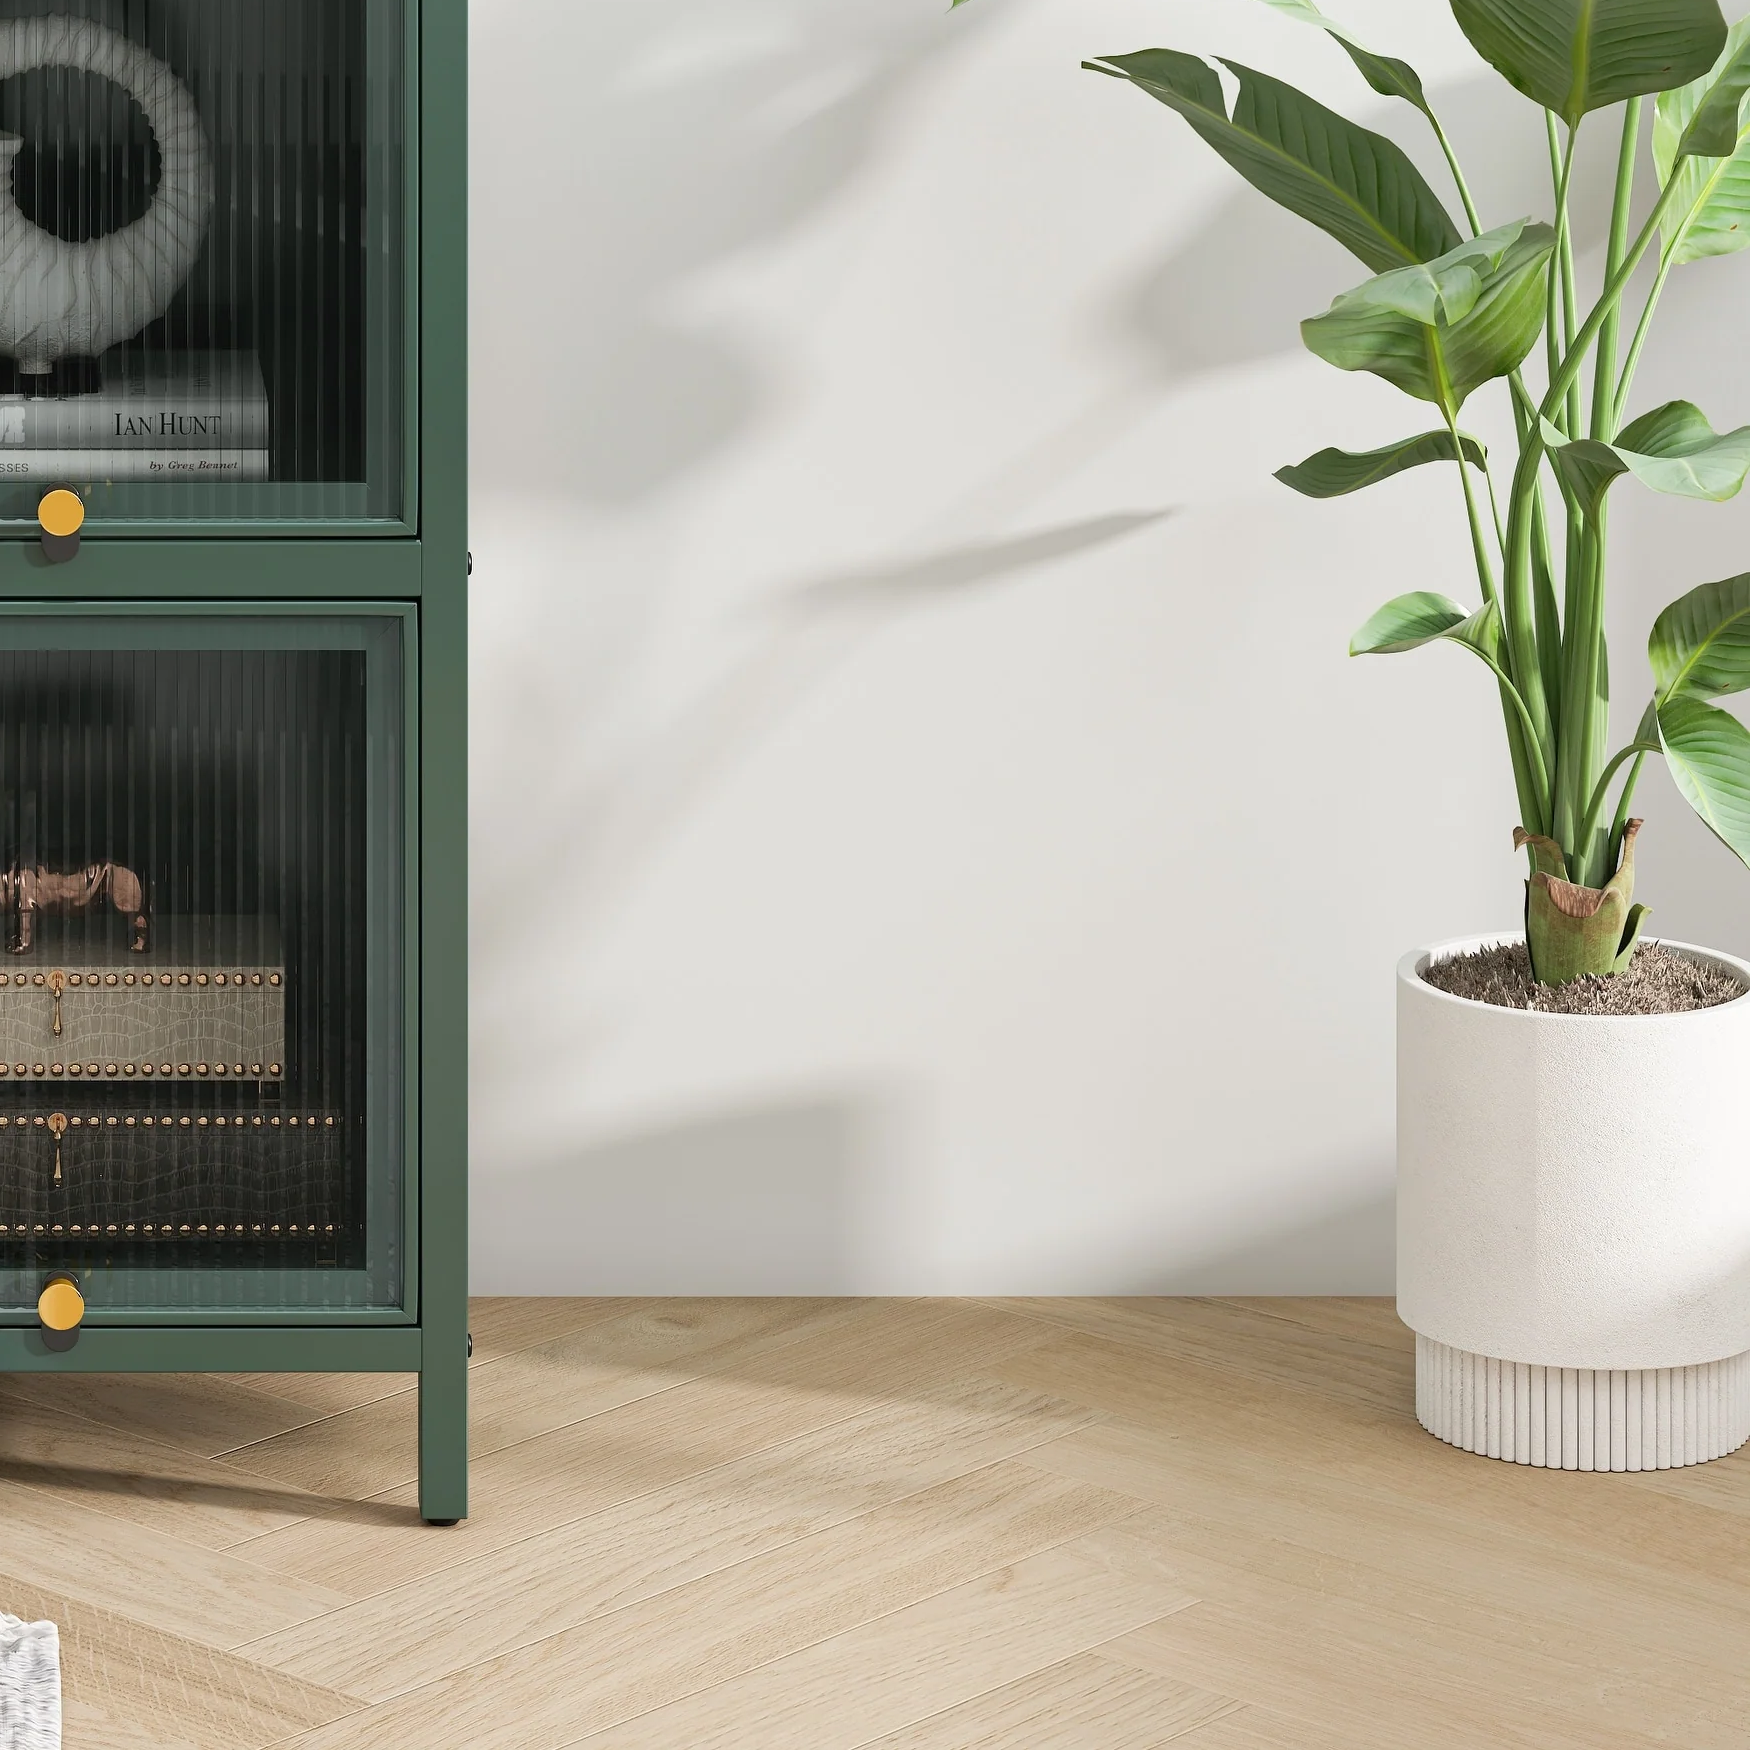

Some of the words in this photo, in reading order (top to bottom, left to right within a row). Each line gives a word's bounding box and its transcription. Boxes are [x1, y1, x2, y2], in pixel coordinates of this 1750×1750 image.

[114, 413, 152, 436] IAN
[159, 411, 221, 436] HUNT
[149, 461, 164, 472] by
[168, 461, 194, 472] Greg
